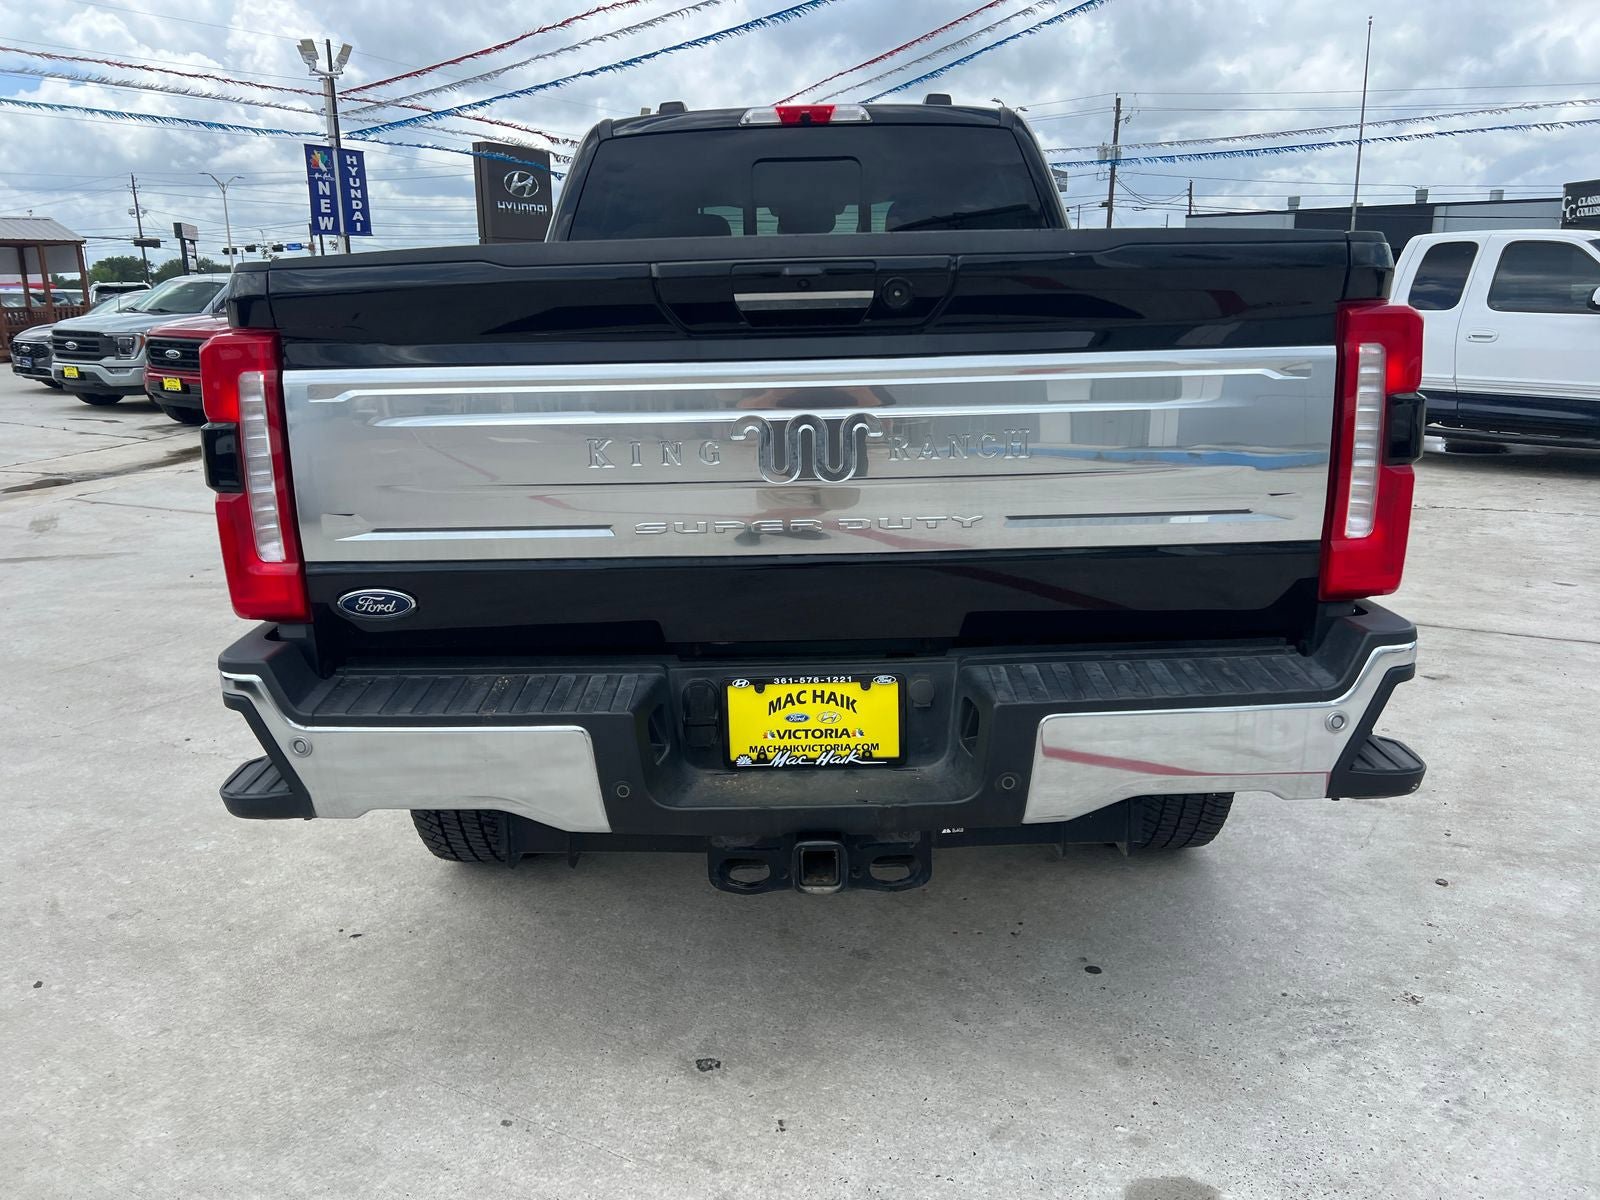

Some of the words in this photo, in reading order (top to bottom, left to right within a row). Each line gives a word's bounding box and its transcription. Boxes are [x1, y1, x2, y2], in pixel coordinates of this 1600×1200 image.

[346, 155, 364, 232] HYUNDAI
[317, 181, 334, 231] NEW
[497, 200, 547, 214] HYUNDAI
[586, 438, 721, 469] KING
[888, 428, 1031, 461] RANCH
[635, 519, 824, 535] SUPER
[838, 515, 984, 530] DUTY
[355, 595, 396, 613] Ford
[773, 676, 852, 684] 361-576-1221
[768, 689, 807, 716] MAC
[812, 689, 857, 714] HAIK
[788, 713, 806, 722] Ford
[776, 728, 851, 740] VICTORIA
[770, 750, 812, 767] Mac
[815, 749, 861, 766] Haik
